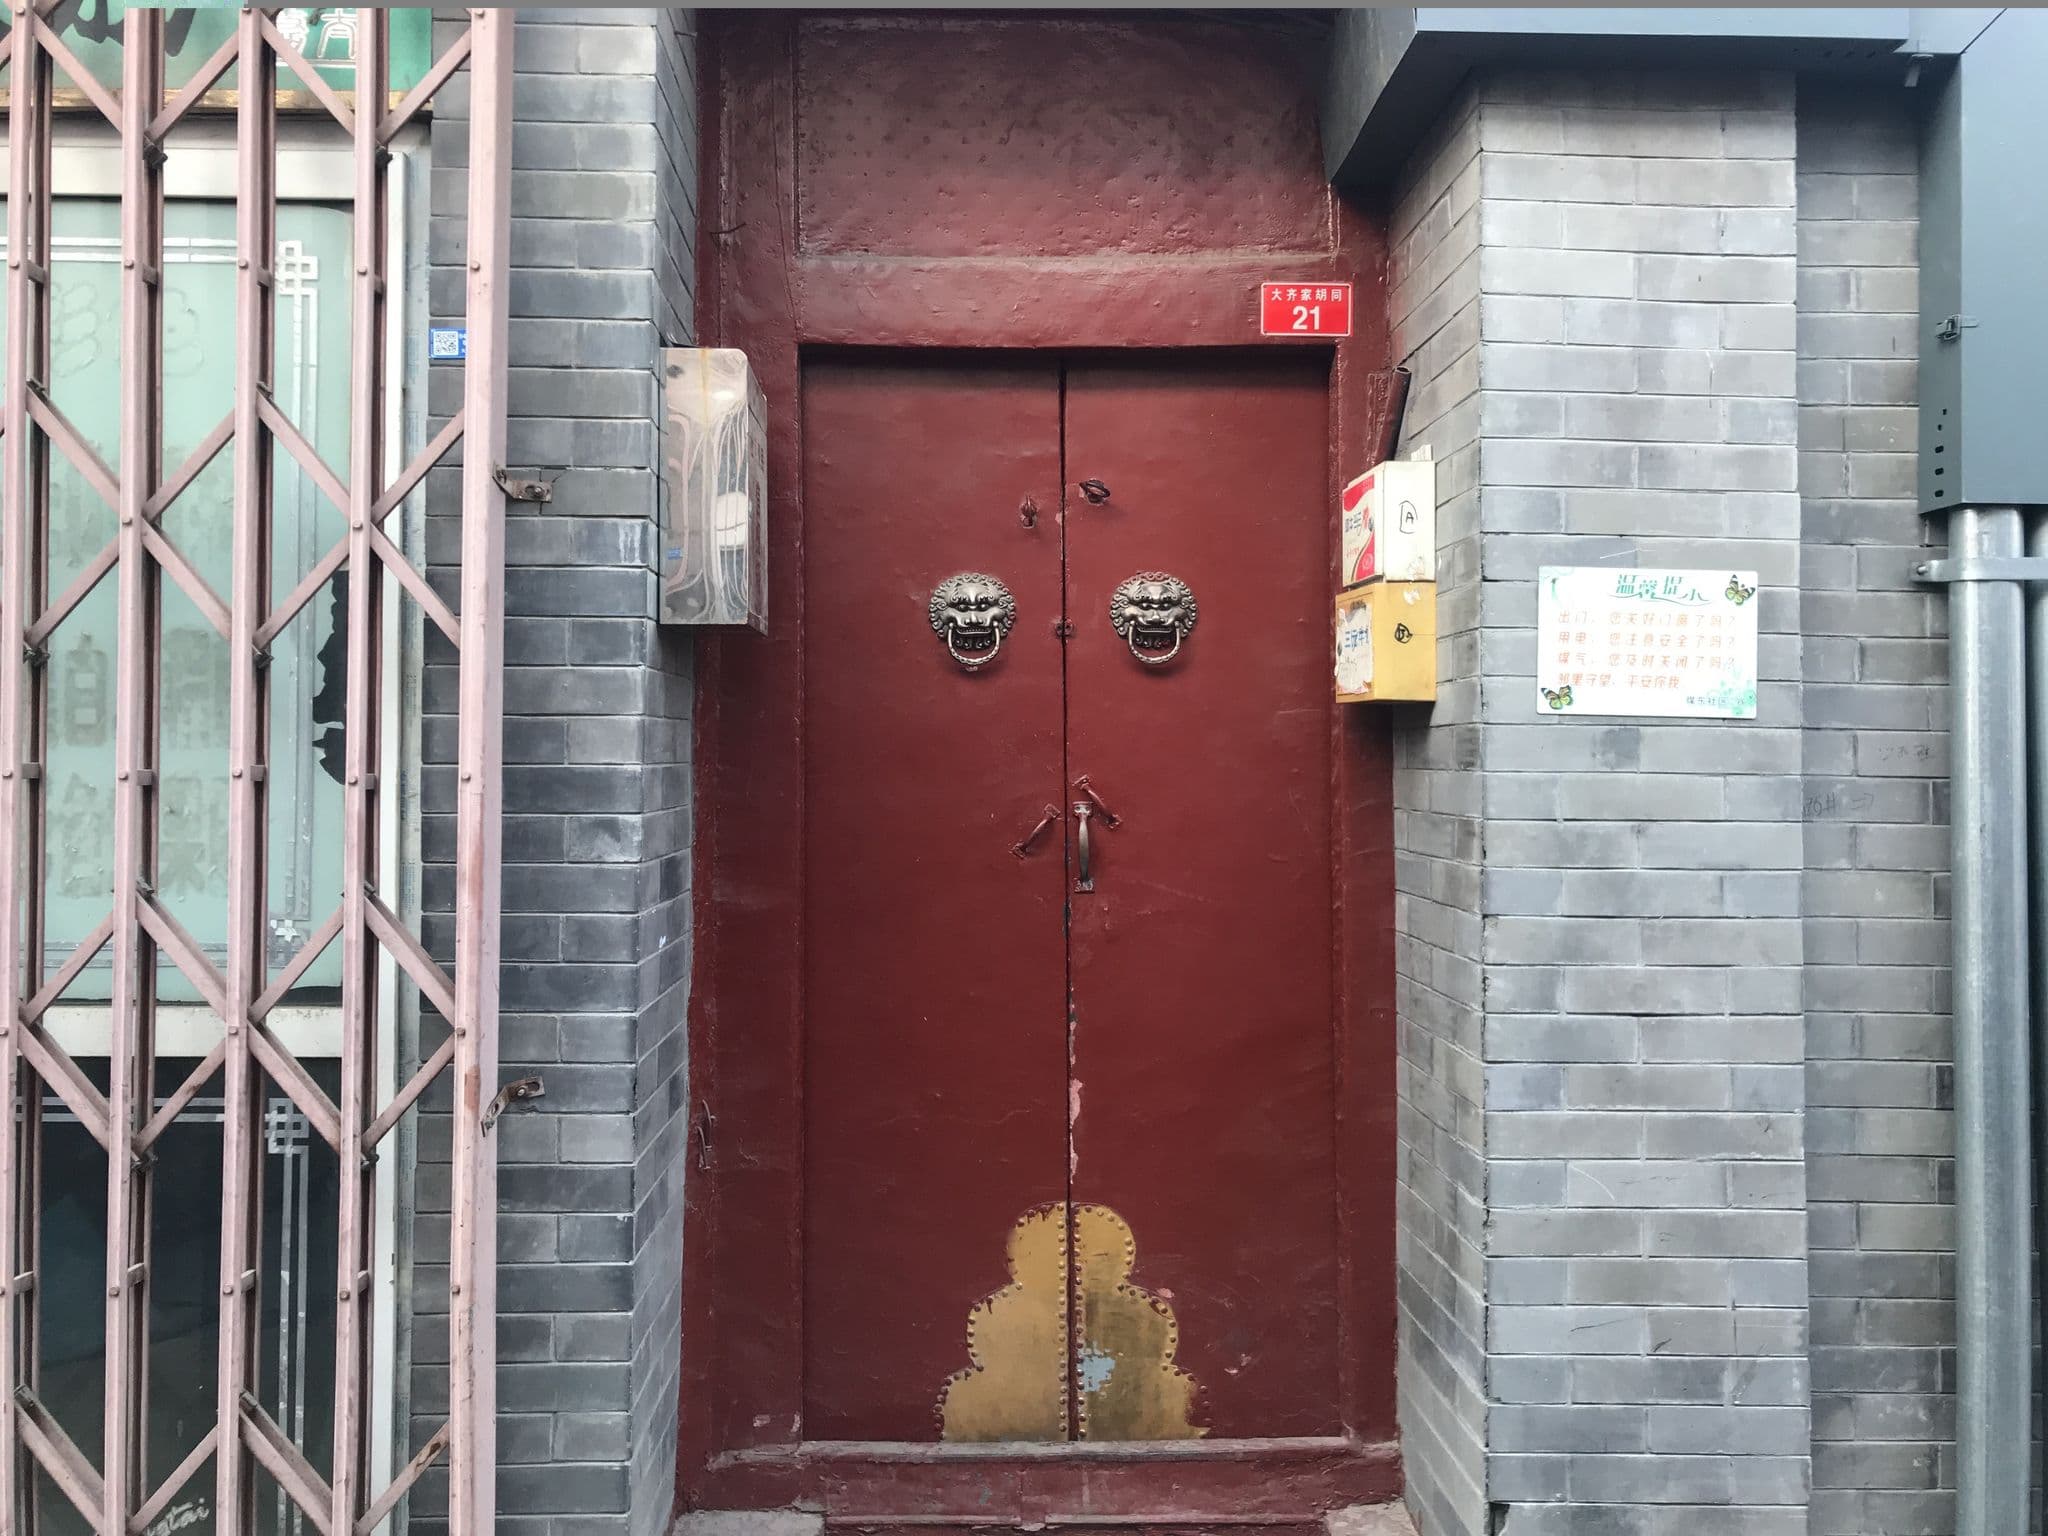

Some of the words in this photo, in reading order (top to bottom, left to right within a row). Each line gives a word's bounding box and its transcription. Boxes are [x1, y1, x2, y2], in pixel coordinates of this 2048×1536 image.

[1271, 288, 1342, 302] 大齐家胡同
[1292, 305, 1320, 330] 21
